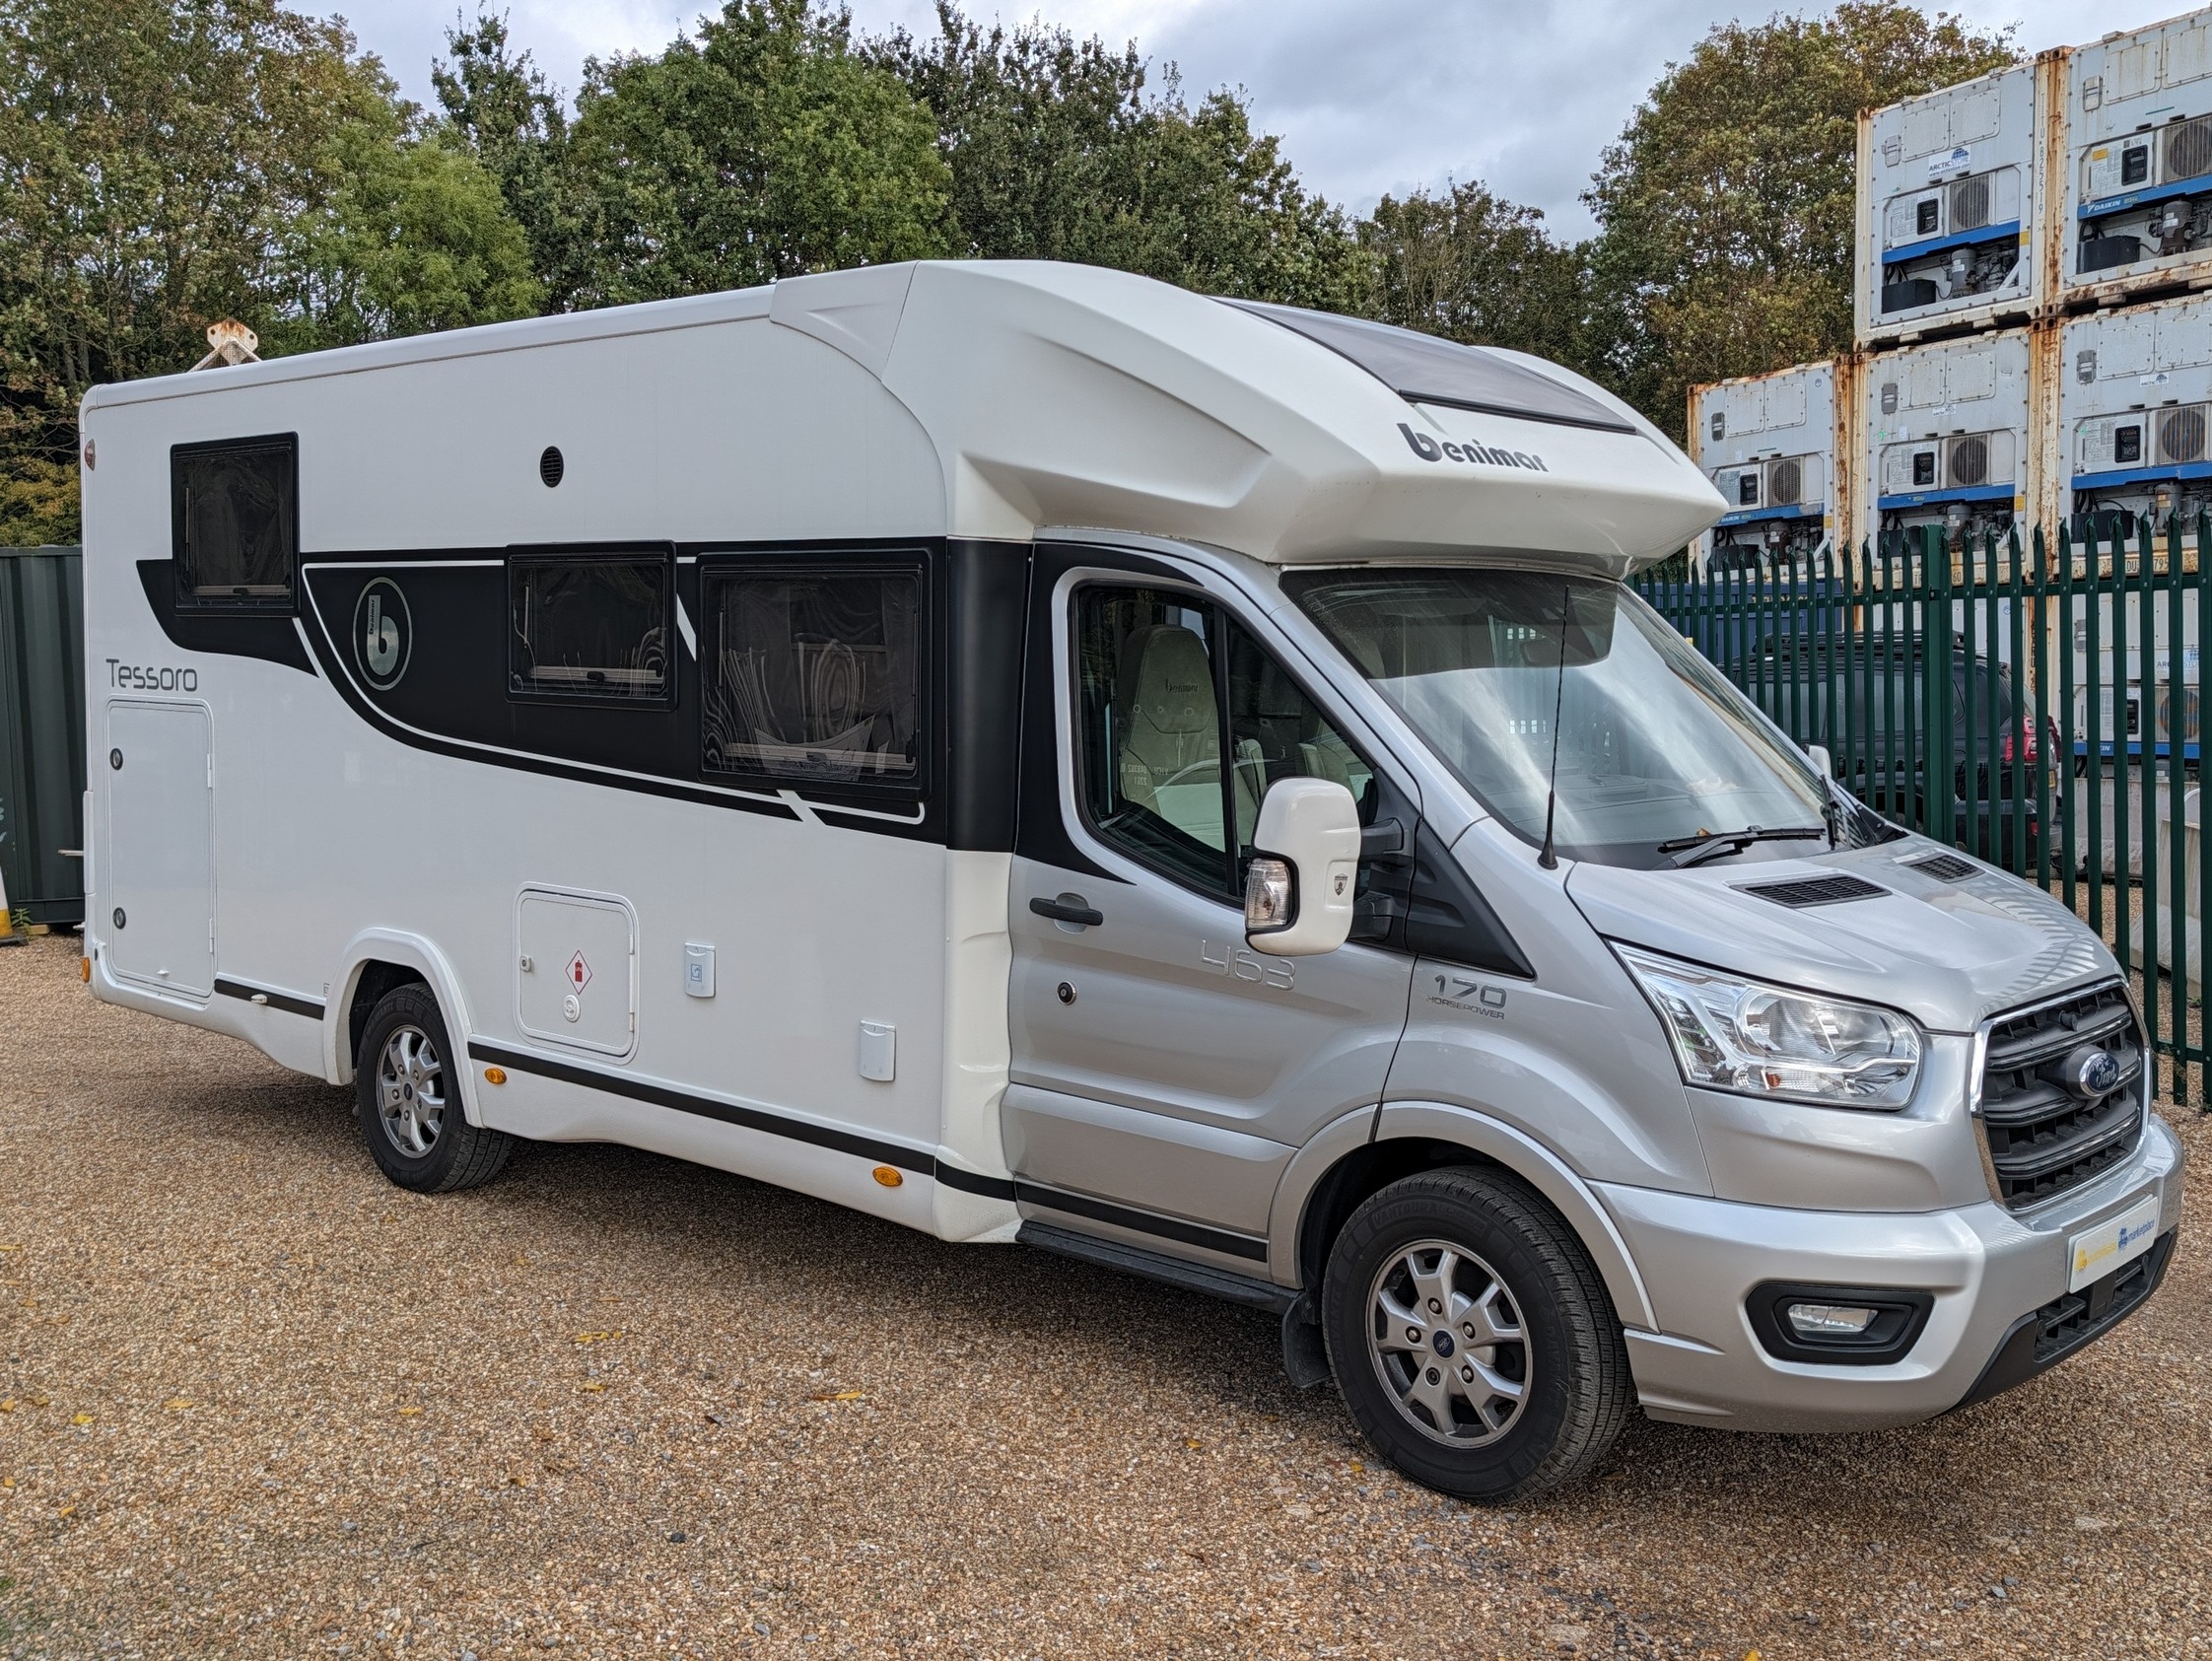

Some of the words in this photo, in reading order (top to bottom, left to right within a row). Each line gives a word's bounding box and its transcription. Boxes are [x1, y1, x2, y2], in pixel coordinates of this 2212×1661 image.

[2093, 198, 2121, 211] DAIKIN
[104, 657, 198, 692] Tessoro
[1199, 938, 1297, 992] 463
[1425, 995, 1506, 1021] HORSEPOWER
[1433, 973, 1507, 1009] 170
